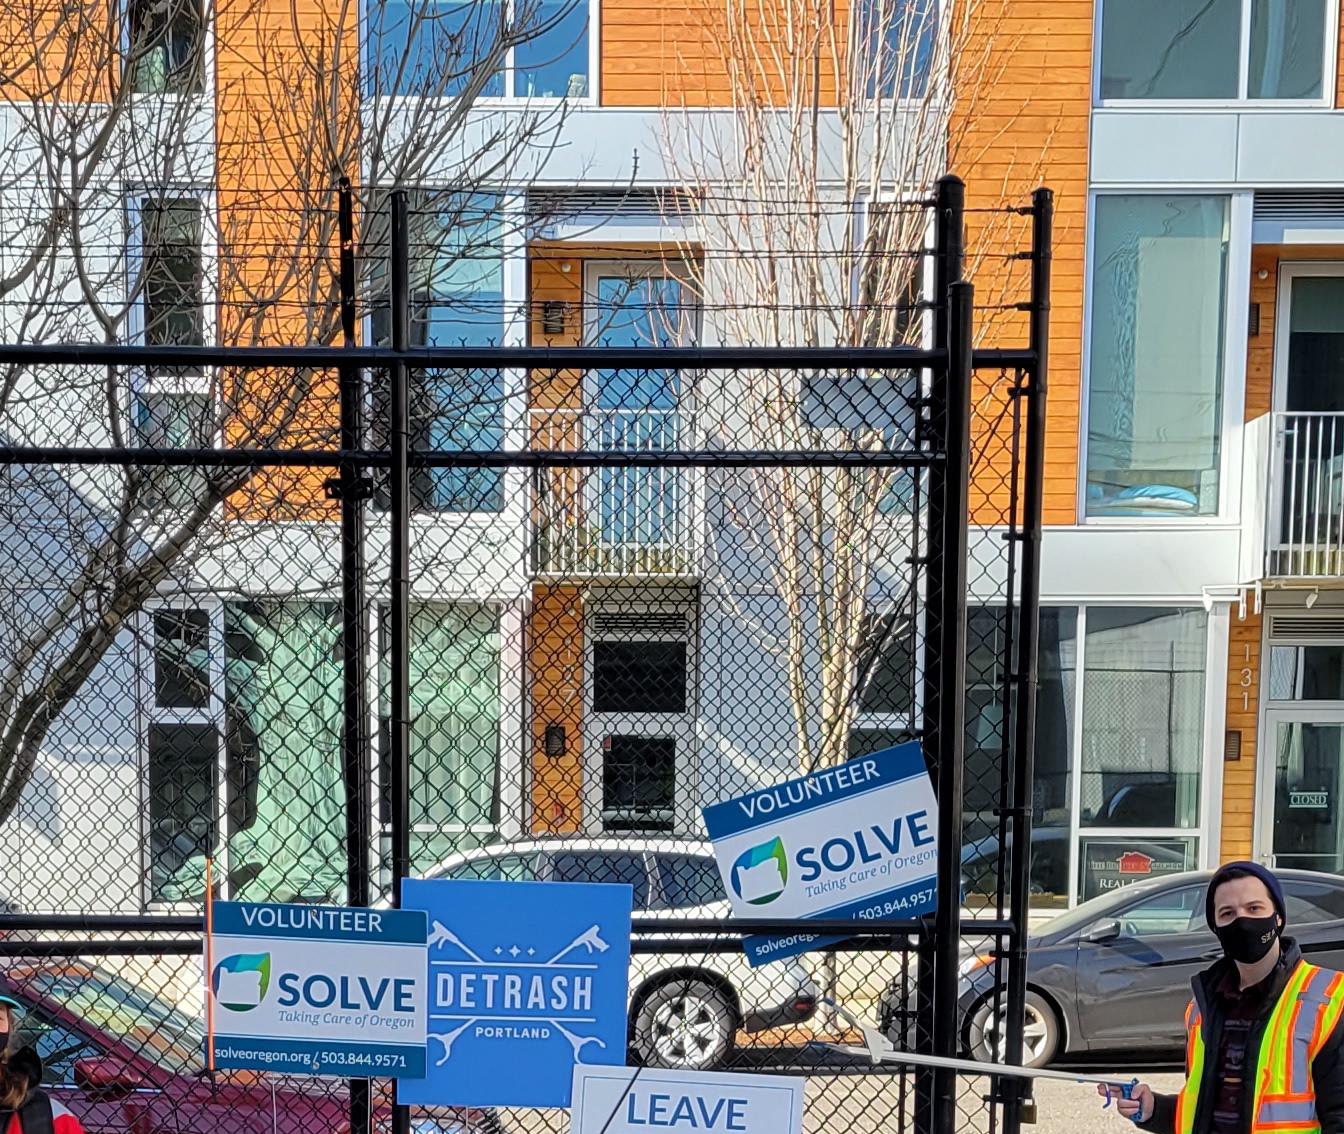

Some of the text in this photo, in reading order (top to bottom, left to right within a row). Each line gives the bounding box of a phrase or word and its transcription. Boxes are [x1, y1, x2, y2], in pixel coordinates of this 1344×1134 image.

[1240, 643, 1252, 711] 131
[739, 760, 881, 818] VOLUNTEER
[1289, 794, 1327, 806] CLOSED
[795, 810, 935, 882] SOLVE
[805, 848, 938, 898] Taking Care of Oregon
[241, 907, 383, 933] VOLUNTEER
[755, 888, 937, 957] solveoreg 503.844.957
[277, 972, 416, 1013] SOLVE
[436, 973, 592, 1011] DETRASH
[279, 1010, 415, 1030] Taking Care of Oregon
[475, 1026, 551, 1039] PORTLAND
[214, 1046, 311, 1065] solveoregon.org
[321, 1052, 407, 1068] 503.844.9571
[627, 1092, 749, 1131] LEAVE
